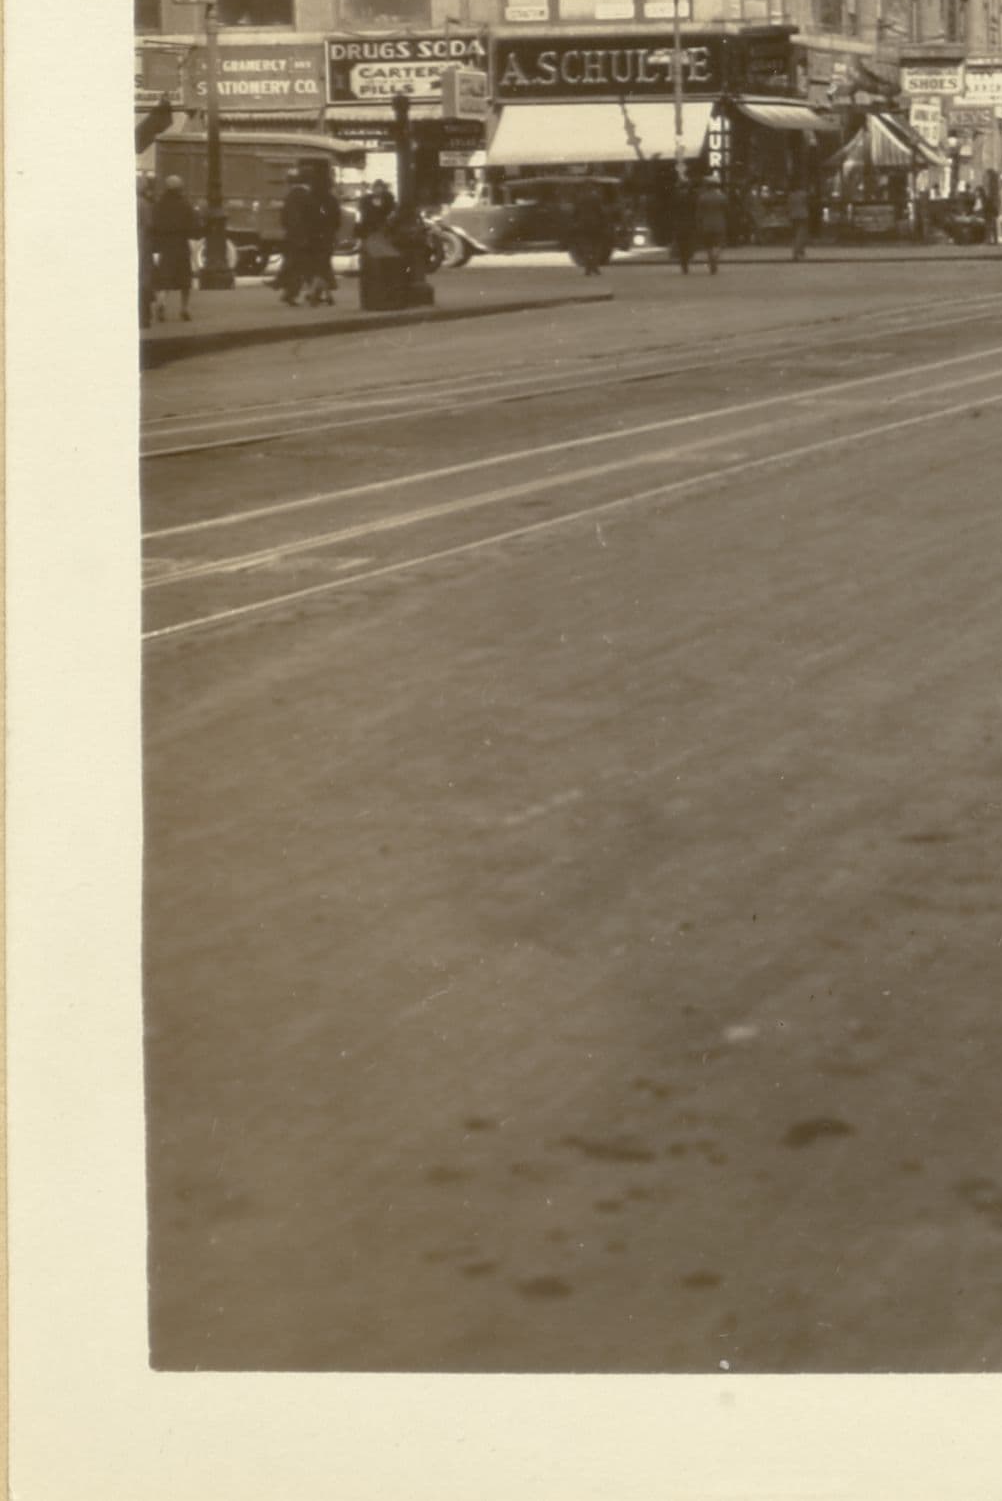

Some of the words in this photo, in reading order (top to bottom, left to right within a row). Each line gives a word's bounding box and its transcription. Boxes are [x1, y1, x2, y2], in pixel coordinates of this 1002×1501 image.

[330, 40, 411, 60] DRUGS
[417, 39, 486, 58] SODA
[222, 58, 287, 73] GRAMERCY
[196, 79, 290, 97] SATIONERY
[360, 83, 415, 95] PILLS
[908, 78, 958, 91] SHOES
